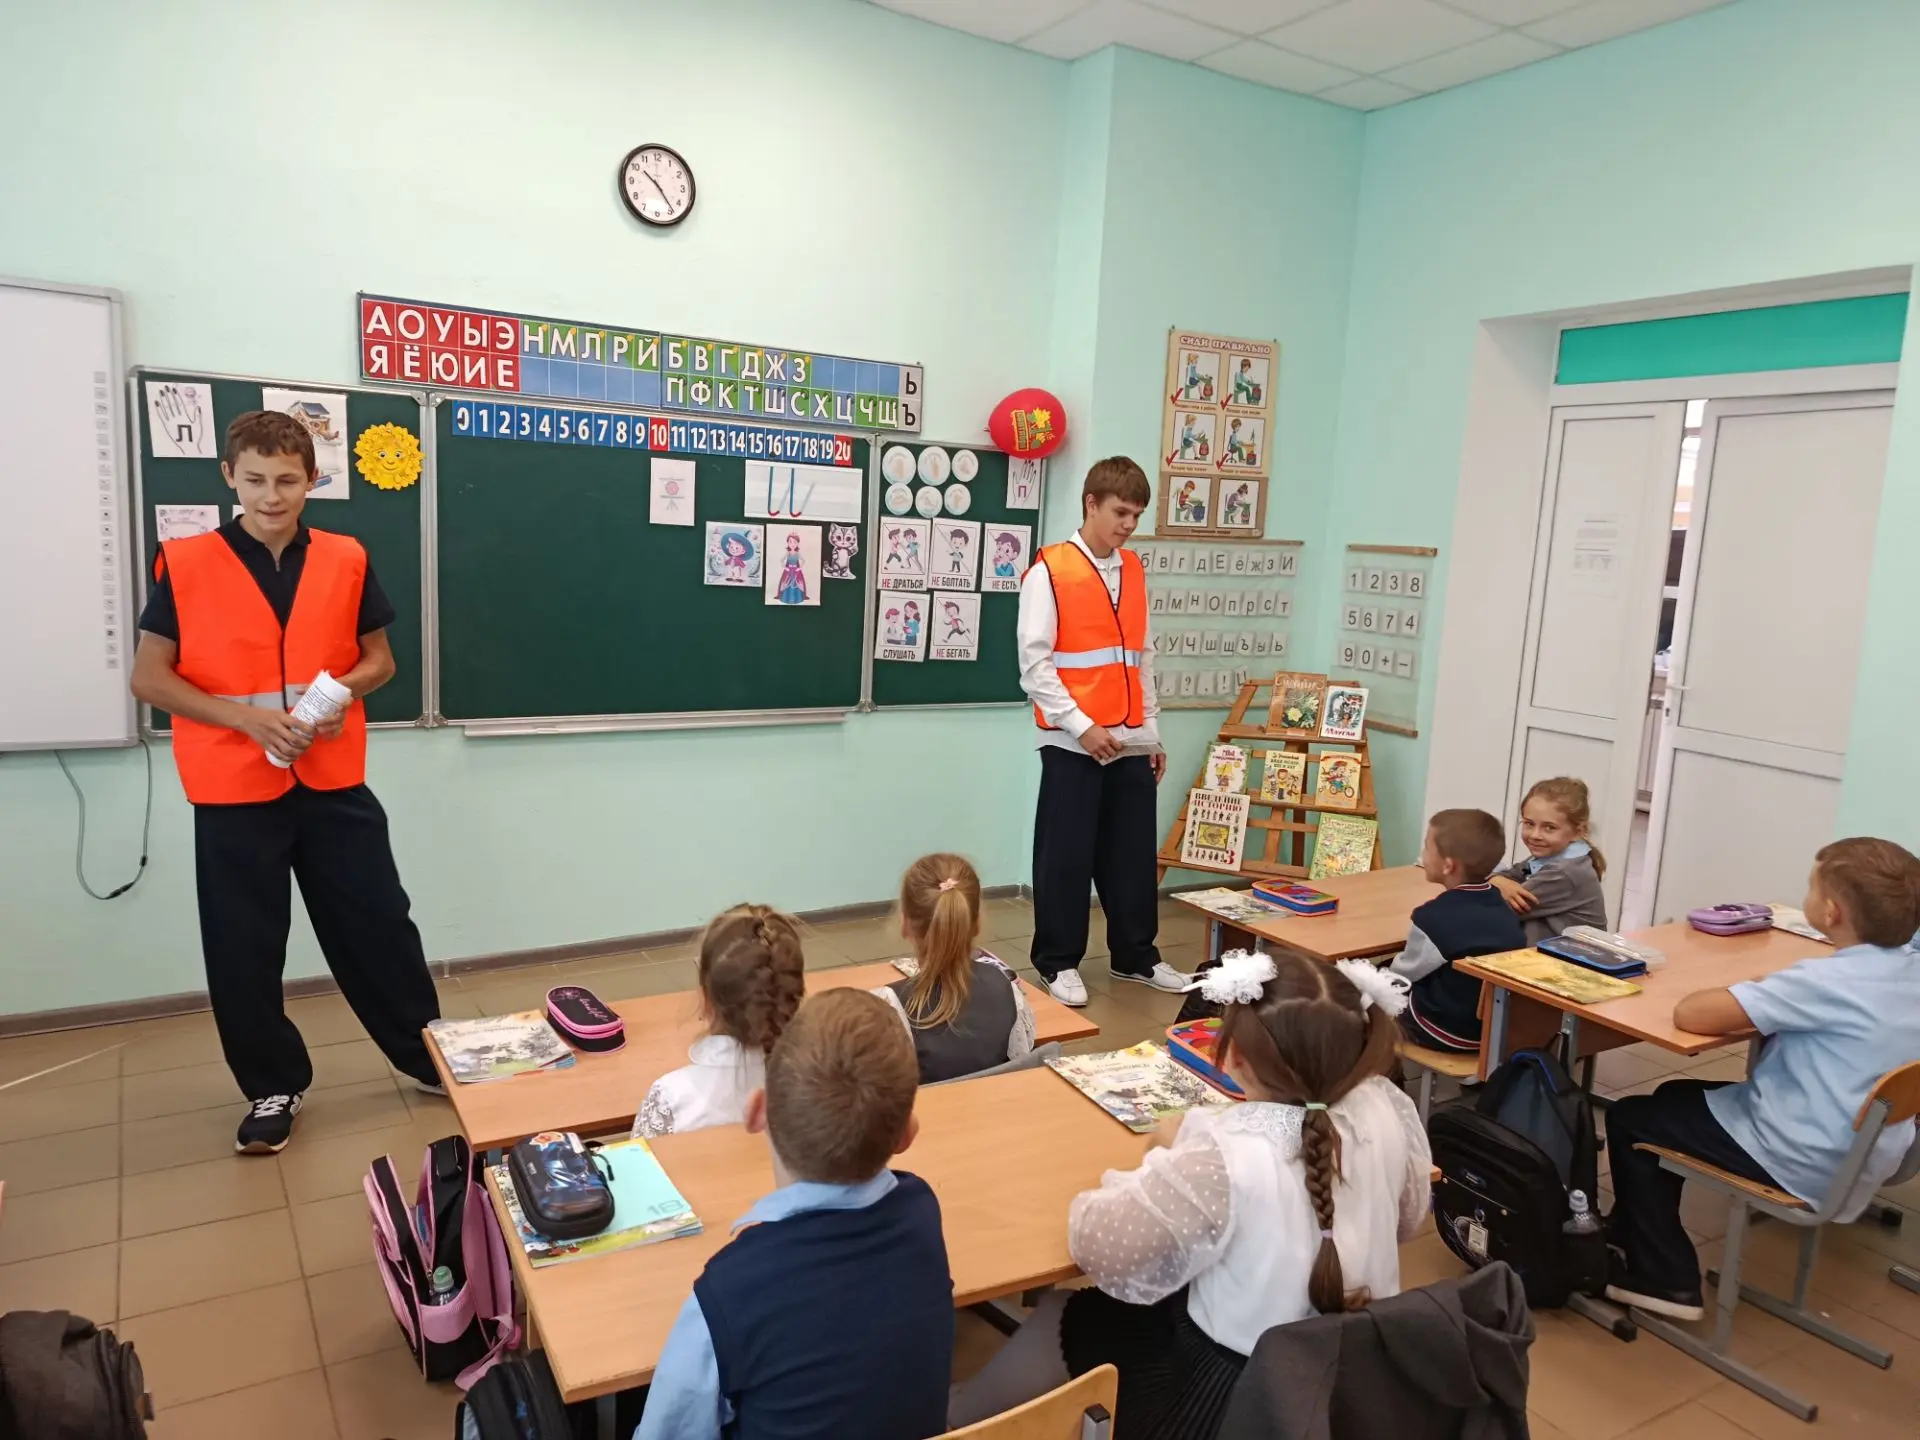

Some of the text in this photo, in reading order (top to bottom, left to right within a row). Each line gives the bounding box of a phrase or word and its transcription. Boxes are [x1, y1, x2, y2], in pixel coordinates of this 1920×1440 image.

[642, 155, 647, 163] 11
[654, 153, 662, 161] 12
[631, 163, 640, 171] 10
[677, 171, 682, 179] 2
[680, 185, 685, 193] 3
[633, 192, 638, 200] 8
[642, 203, 646, 211] 7
[366, 306, 514, 350] А О У Ы Э
[523, 324, 657, 368] Н М Л Р Й
[1180, 336, 1270, 354] СИДИ ПРАВИЛЬНО
[370, 343, 513, 388] Я Ё Ю И Е
[668, 343, 683, 369] Б
[694, 346, 708, 370] В
[721, 349, 734, 373] Г
[741, 352, 760, 380] Д
[765, 354, 786, 380] Ж
[666, 378, 898, 428] П Ф К Т Ш С Х Ц Ч Щ
[457, 408, 850, 460] 0 1 2 3 4 5 6 7 8 9 10 11 12 13 14 15 16 17 18 19 20
[882, 579, 923, 588] НЕ ДРАТЬСЯ
[932, 577, 970, 588] НЕ БОЛТАТЬ
[992, 580, 1017, 590] НЕ ЕСТЬ
[1371, 574, 1379, 589] 2
[1390, 575, 1398, 590] 3
[1410, 578, 1419, 592] 8
[1348, 611, 1415, 629] 5 6 7 4
[883, 649, 915, 659] СЛУШАТЬ
[936, 648, 970, 658] НЕ БЕГАТЬ
[1345, 648, 1353, 661] 9
[1362, 650, 1370, 664] 0
